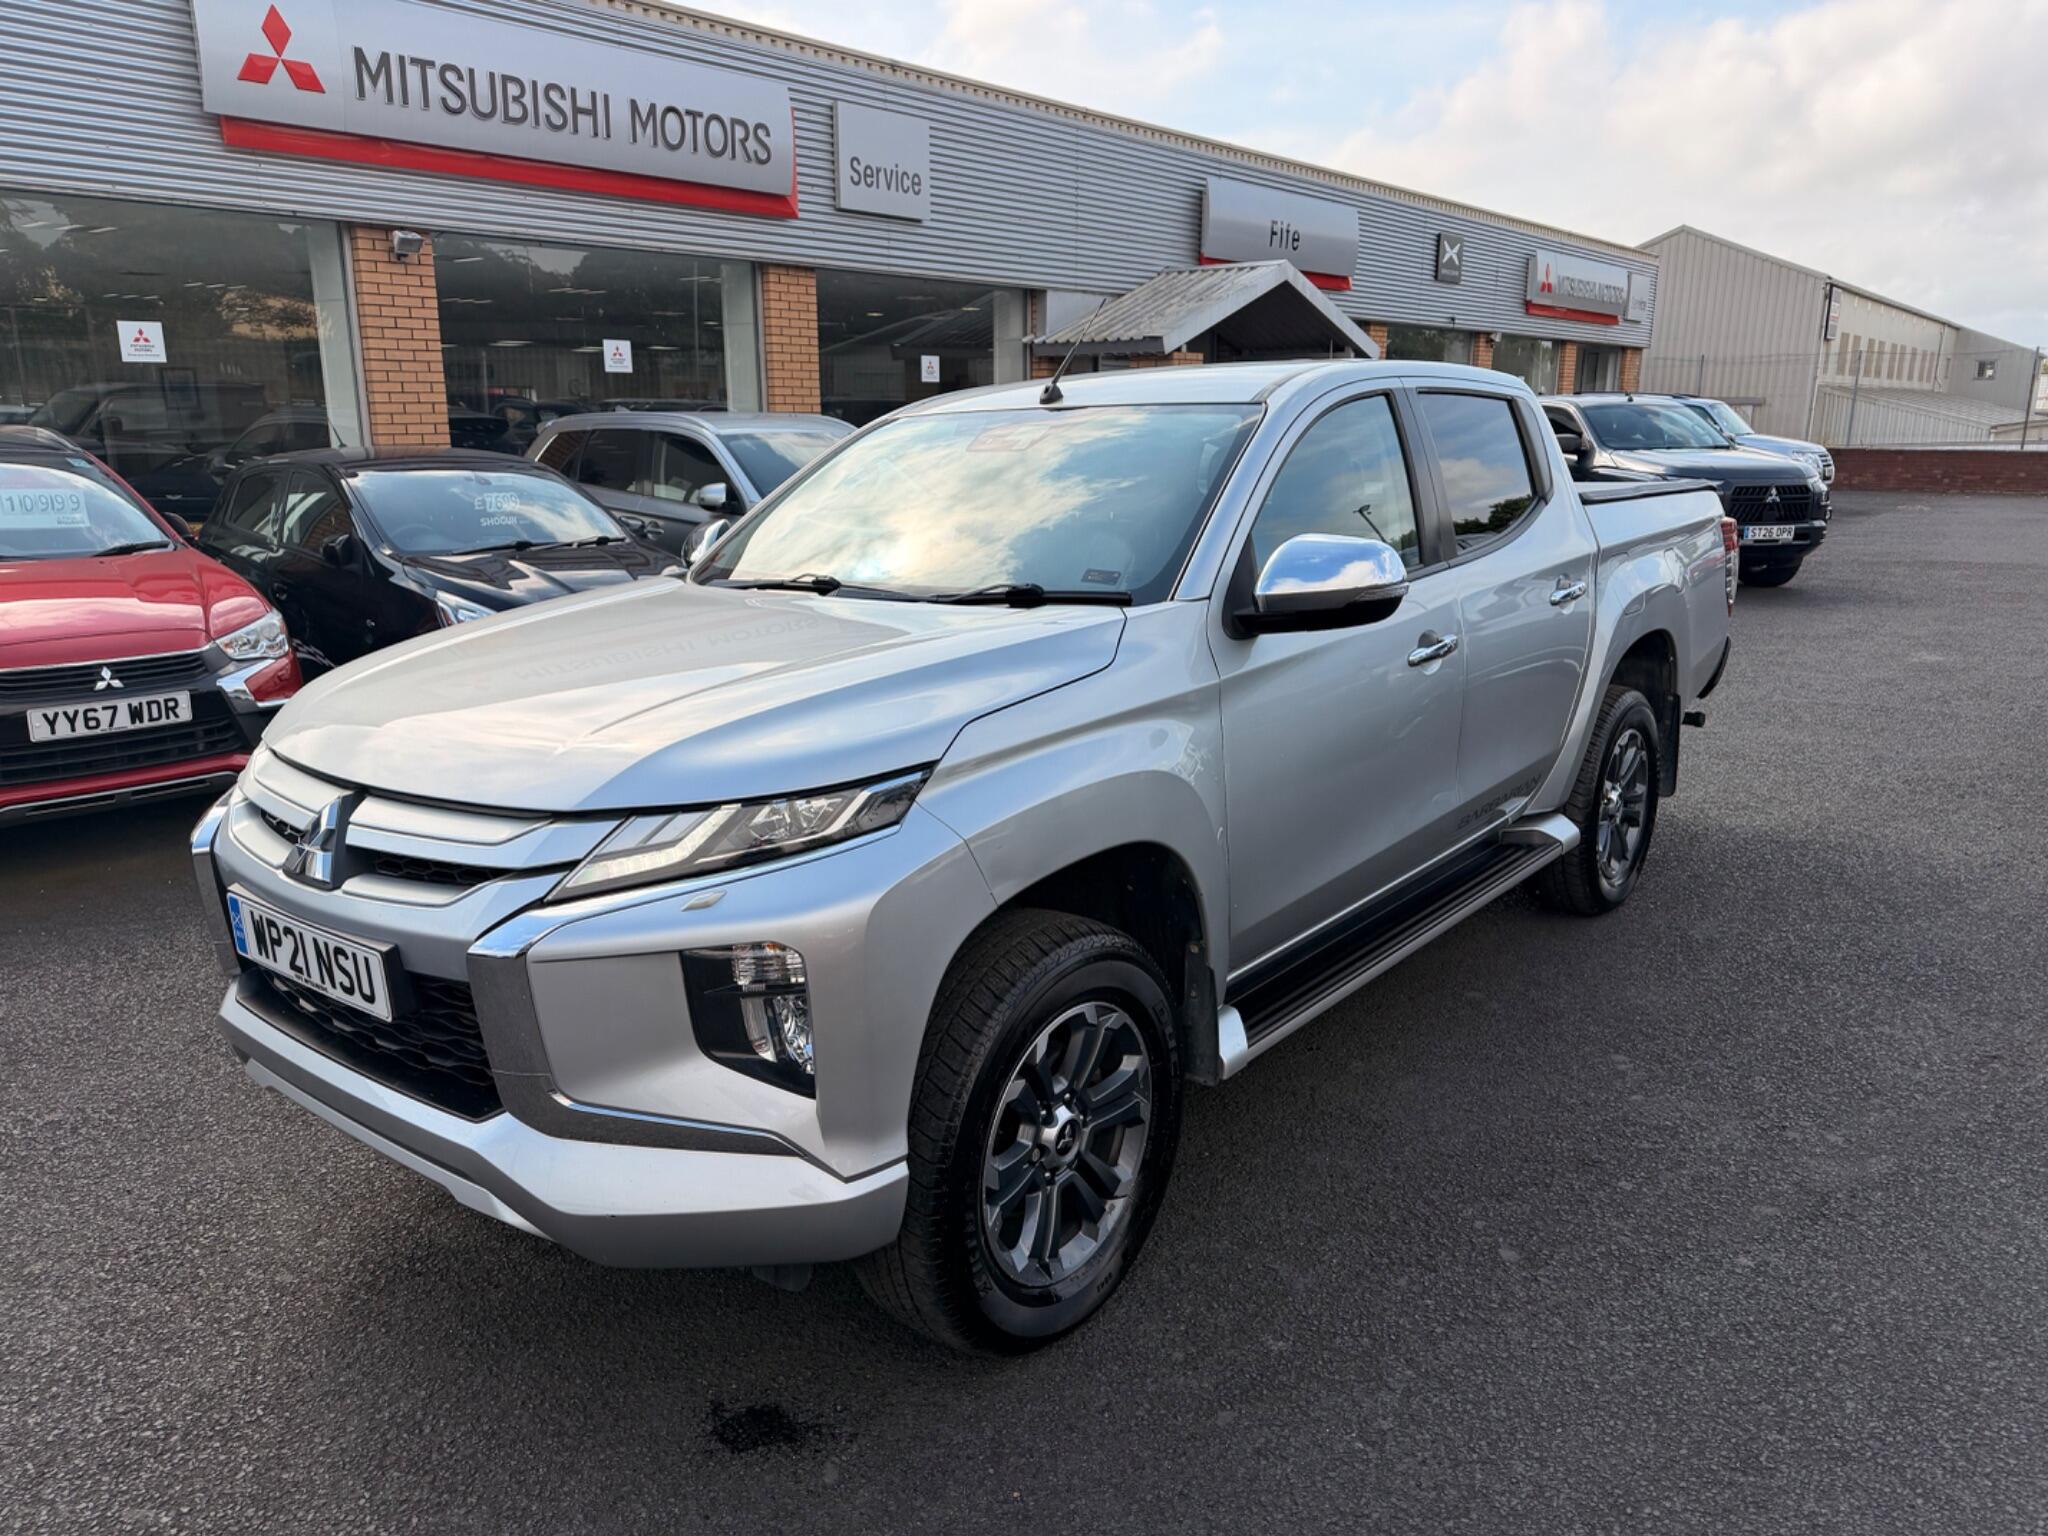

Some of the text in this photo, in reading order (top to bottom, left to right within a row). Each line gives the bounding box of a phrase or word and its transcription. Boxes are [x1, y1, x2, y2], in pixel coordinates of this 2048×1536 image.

[353, 46, 772, 166] MITSUBISHI MOTORS
[849, 156, 922, 196] Service
[1269, 220, 1301, 251] Fife
[1750, 527, 1775, 538] ST26
[42, 697, 180, 735] YY67 WDR
[249, 910, 376, 1005] WP21 NSU
